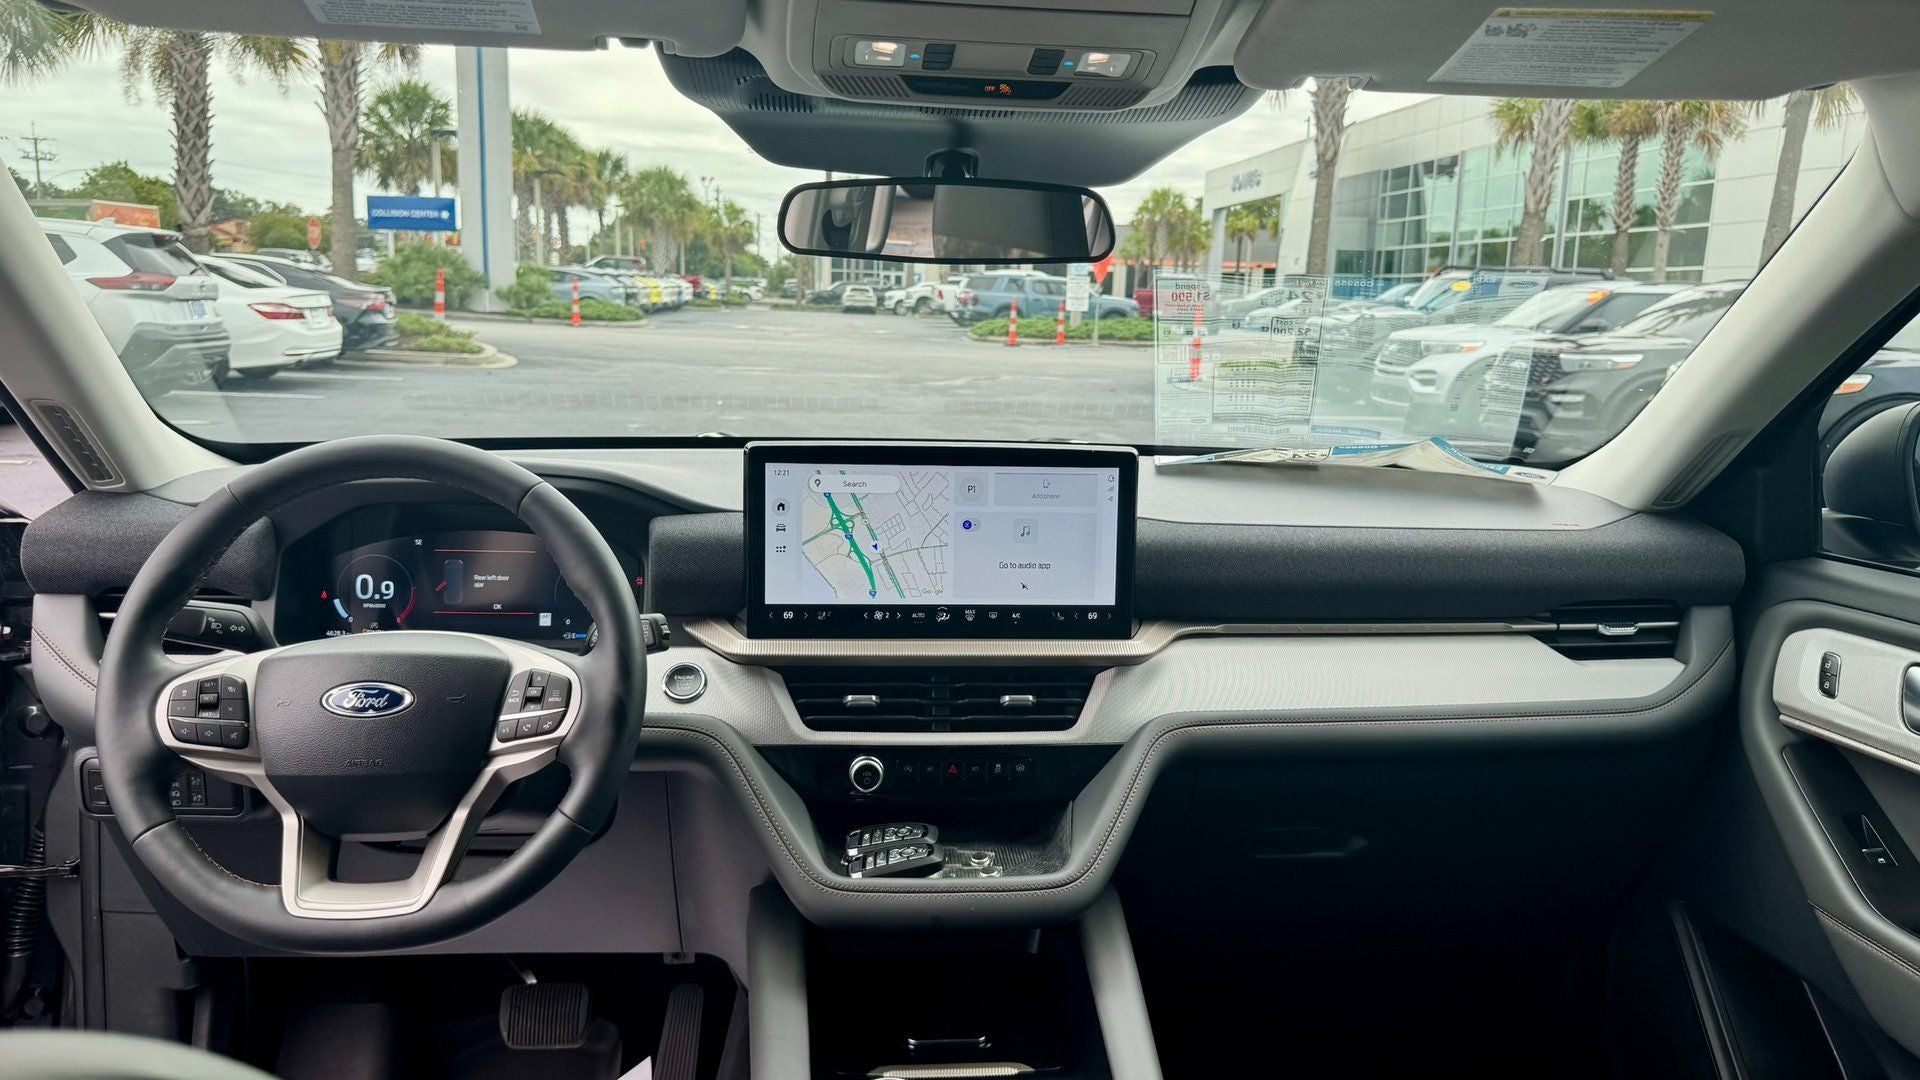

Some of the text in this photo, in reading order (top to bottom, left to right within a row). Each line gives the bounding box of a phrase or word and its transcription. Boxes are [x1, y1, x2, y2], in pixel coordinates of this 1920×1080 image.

[842, 480, 867, 488] Search
[967, 485, 976, 493] P1
[999, 561, 1008, 569] Go
[1017, 561, 1036, 569] audio
[1038, 563, 1051, 571] app
[355, 573, 395, 600] 0.9
[921, 588, 943, 596] Google
[783, 611, 794, 619] 69
[1087, 612, 1098, 620] 69
[343, 689, 390, 709] Ford
